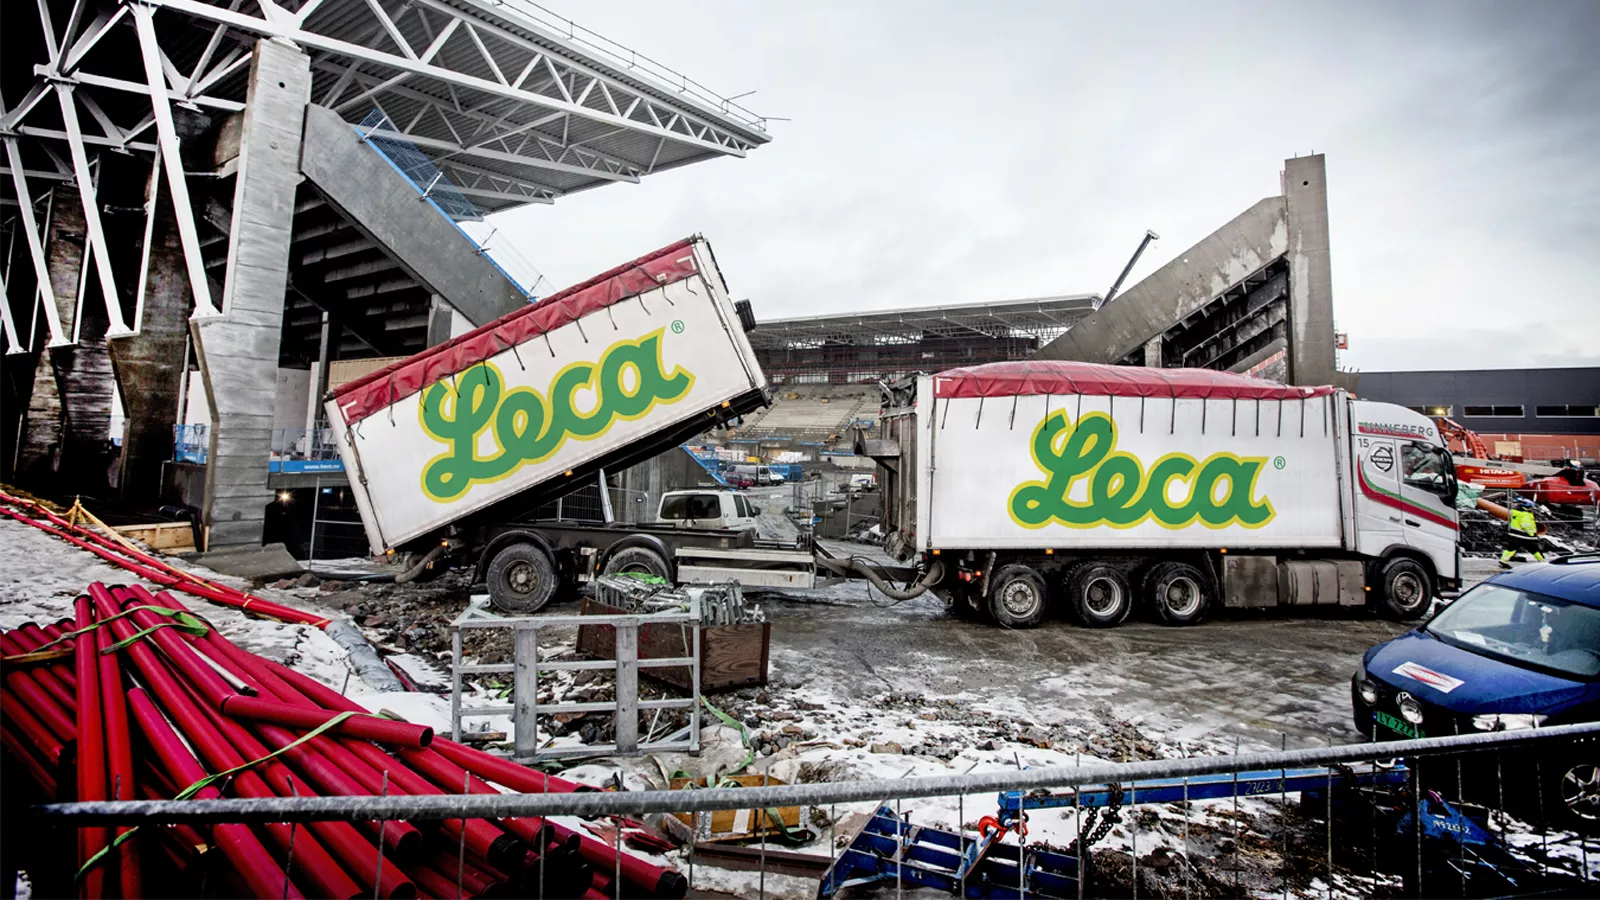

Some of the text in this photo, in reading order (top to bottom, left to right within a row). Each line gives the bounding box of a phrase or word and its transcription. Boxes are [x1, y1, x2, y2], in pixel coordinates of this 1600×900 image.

[419, 327, 696, 503] Leca
[1358, 438, 1369, 448] 15
[1364, 421, 1434, 437] UNNEBERG
[1008, 408, 1277, 530] Leca
